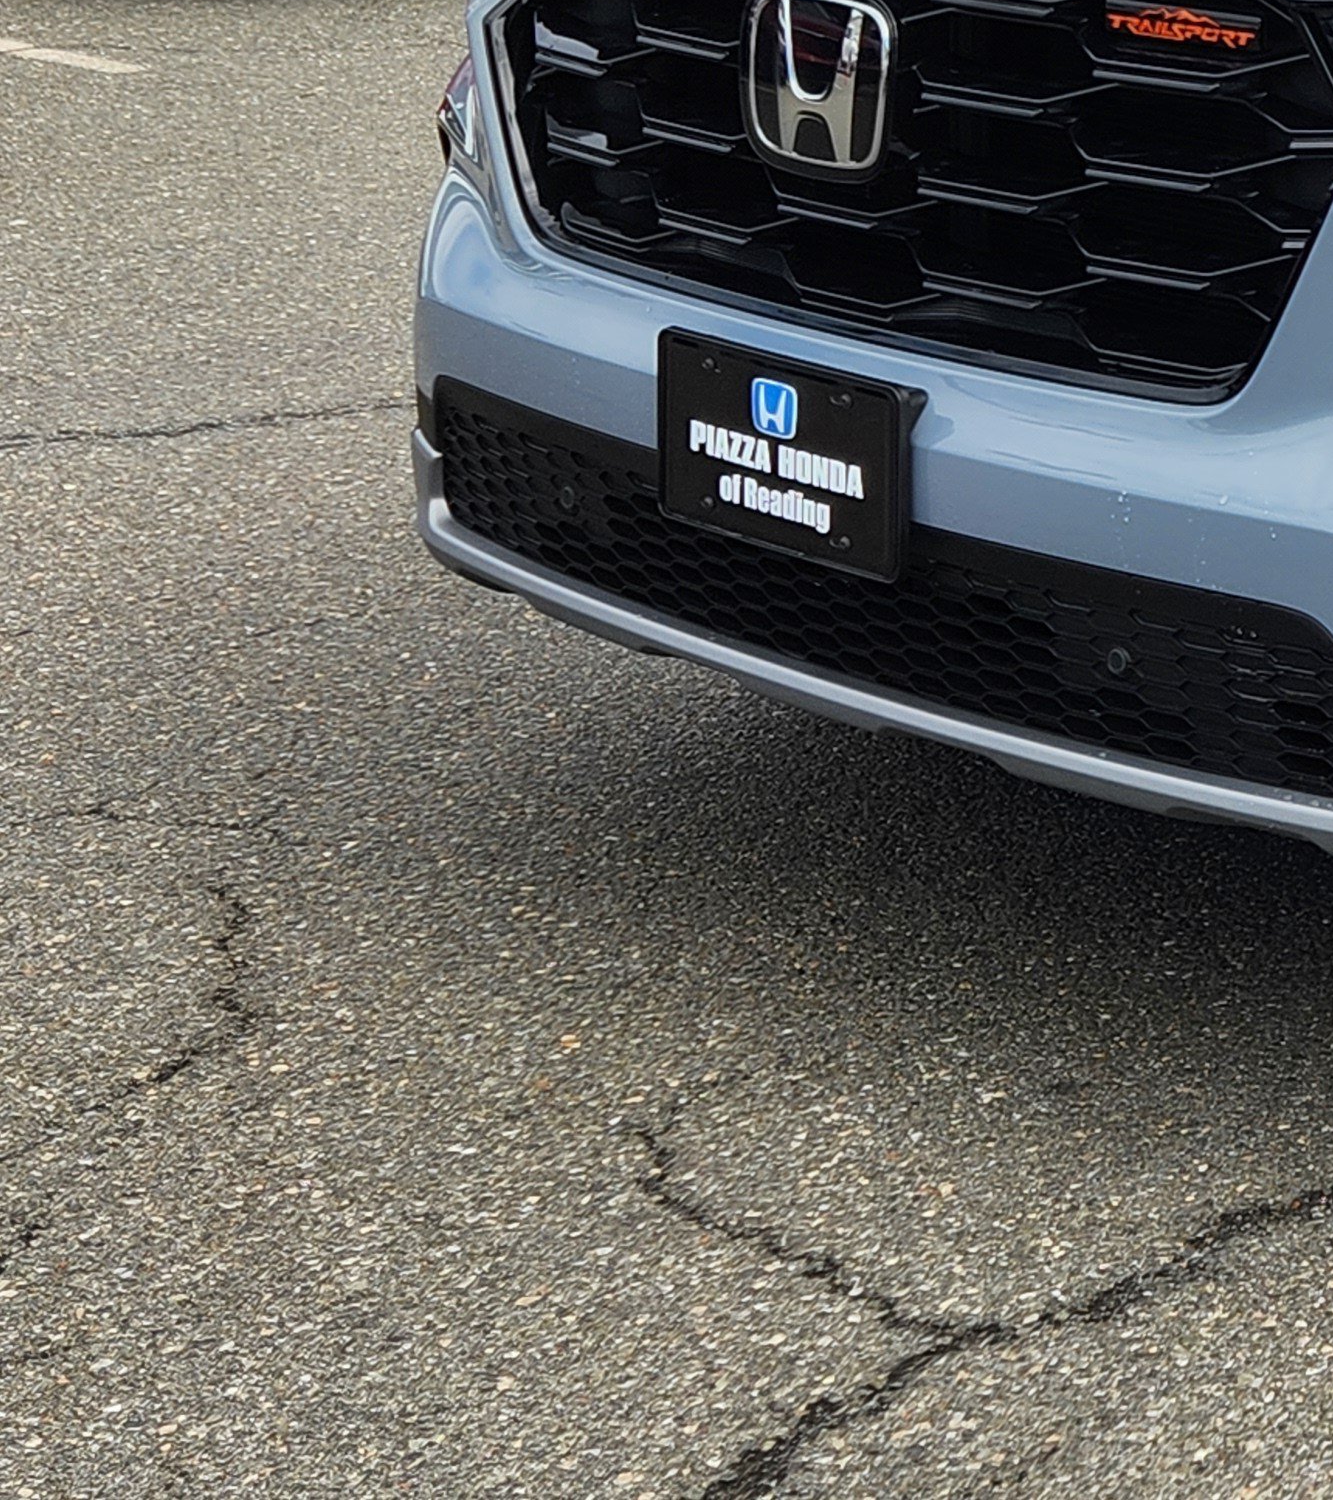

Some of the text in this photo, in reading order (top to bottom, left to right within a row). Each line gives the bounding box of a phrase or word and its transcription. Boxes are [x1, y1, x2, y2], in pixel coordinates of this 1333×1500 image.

[1105, 13, 1256, 49] TRAILSPORT
[689, 419, 865, 500] PIAZZA HONDA
[719, 473, 832, 535] of Reading
